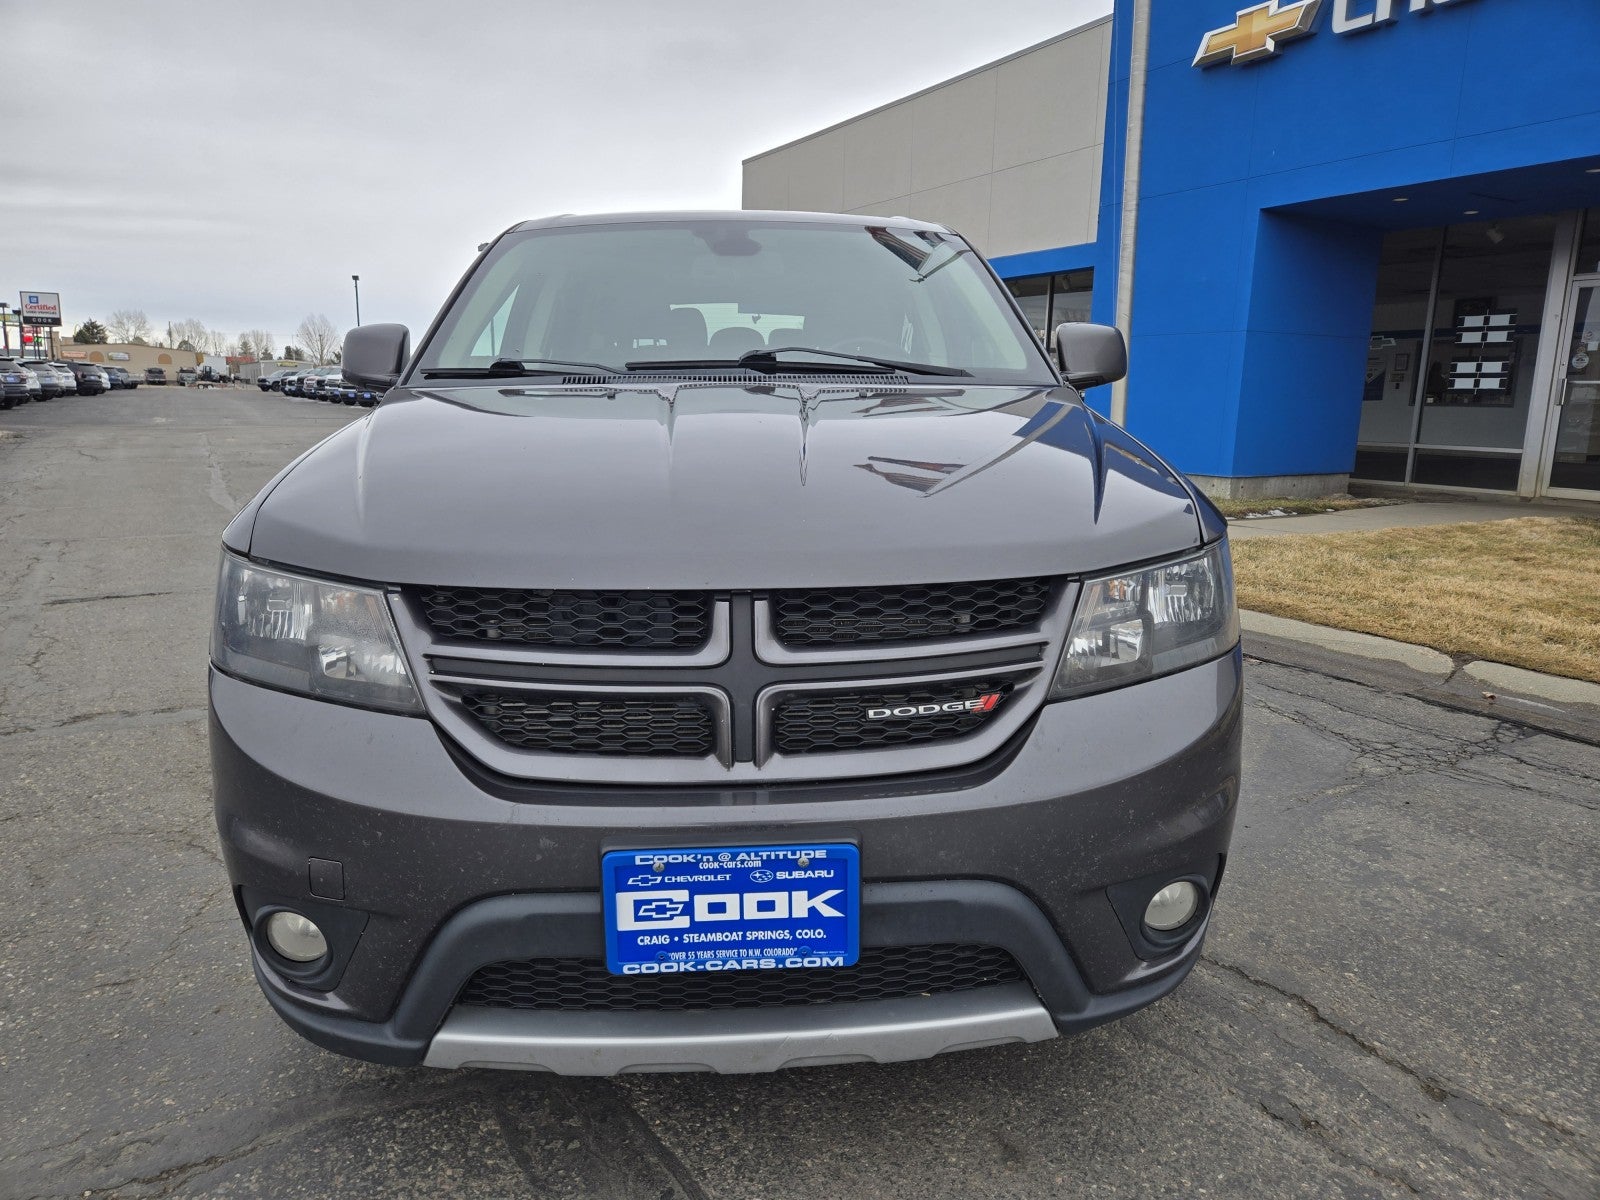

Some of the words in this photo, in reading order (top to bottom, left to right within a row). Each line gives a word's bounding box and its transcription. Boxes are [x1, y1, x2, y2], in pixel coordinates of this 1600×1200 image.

[868, 700, 984, 719] DODGE
[736, 850, 827, 860] ALTITUDE
[665, 874, 731, 883] CHEVROLET
[776, 870, 834, 879] SUBARU
[616, 889, 845, 931] COOK
[637, 935, 670, 945] CRAIG
[683, 931, 743, 943] STEAMBOAT
[746, 930, 793, 940] SPRINGS,
[796, 928, 827, 939] COLO.
[688, 951, 695, 959] 55
[697, 951, 714, 959] YEARS
[716, 949, 738, 958] SERVICE
[740, 949, 747, 957] TO
[622, 957, 844, 975] COOK-CARS.COM
